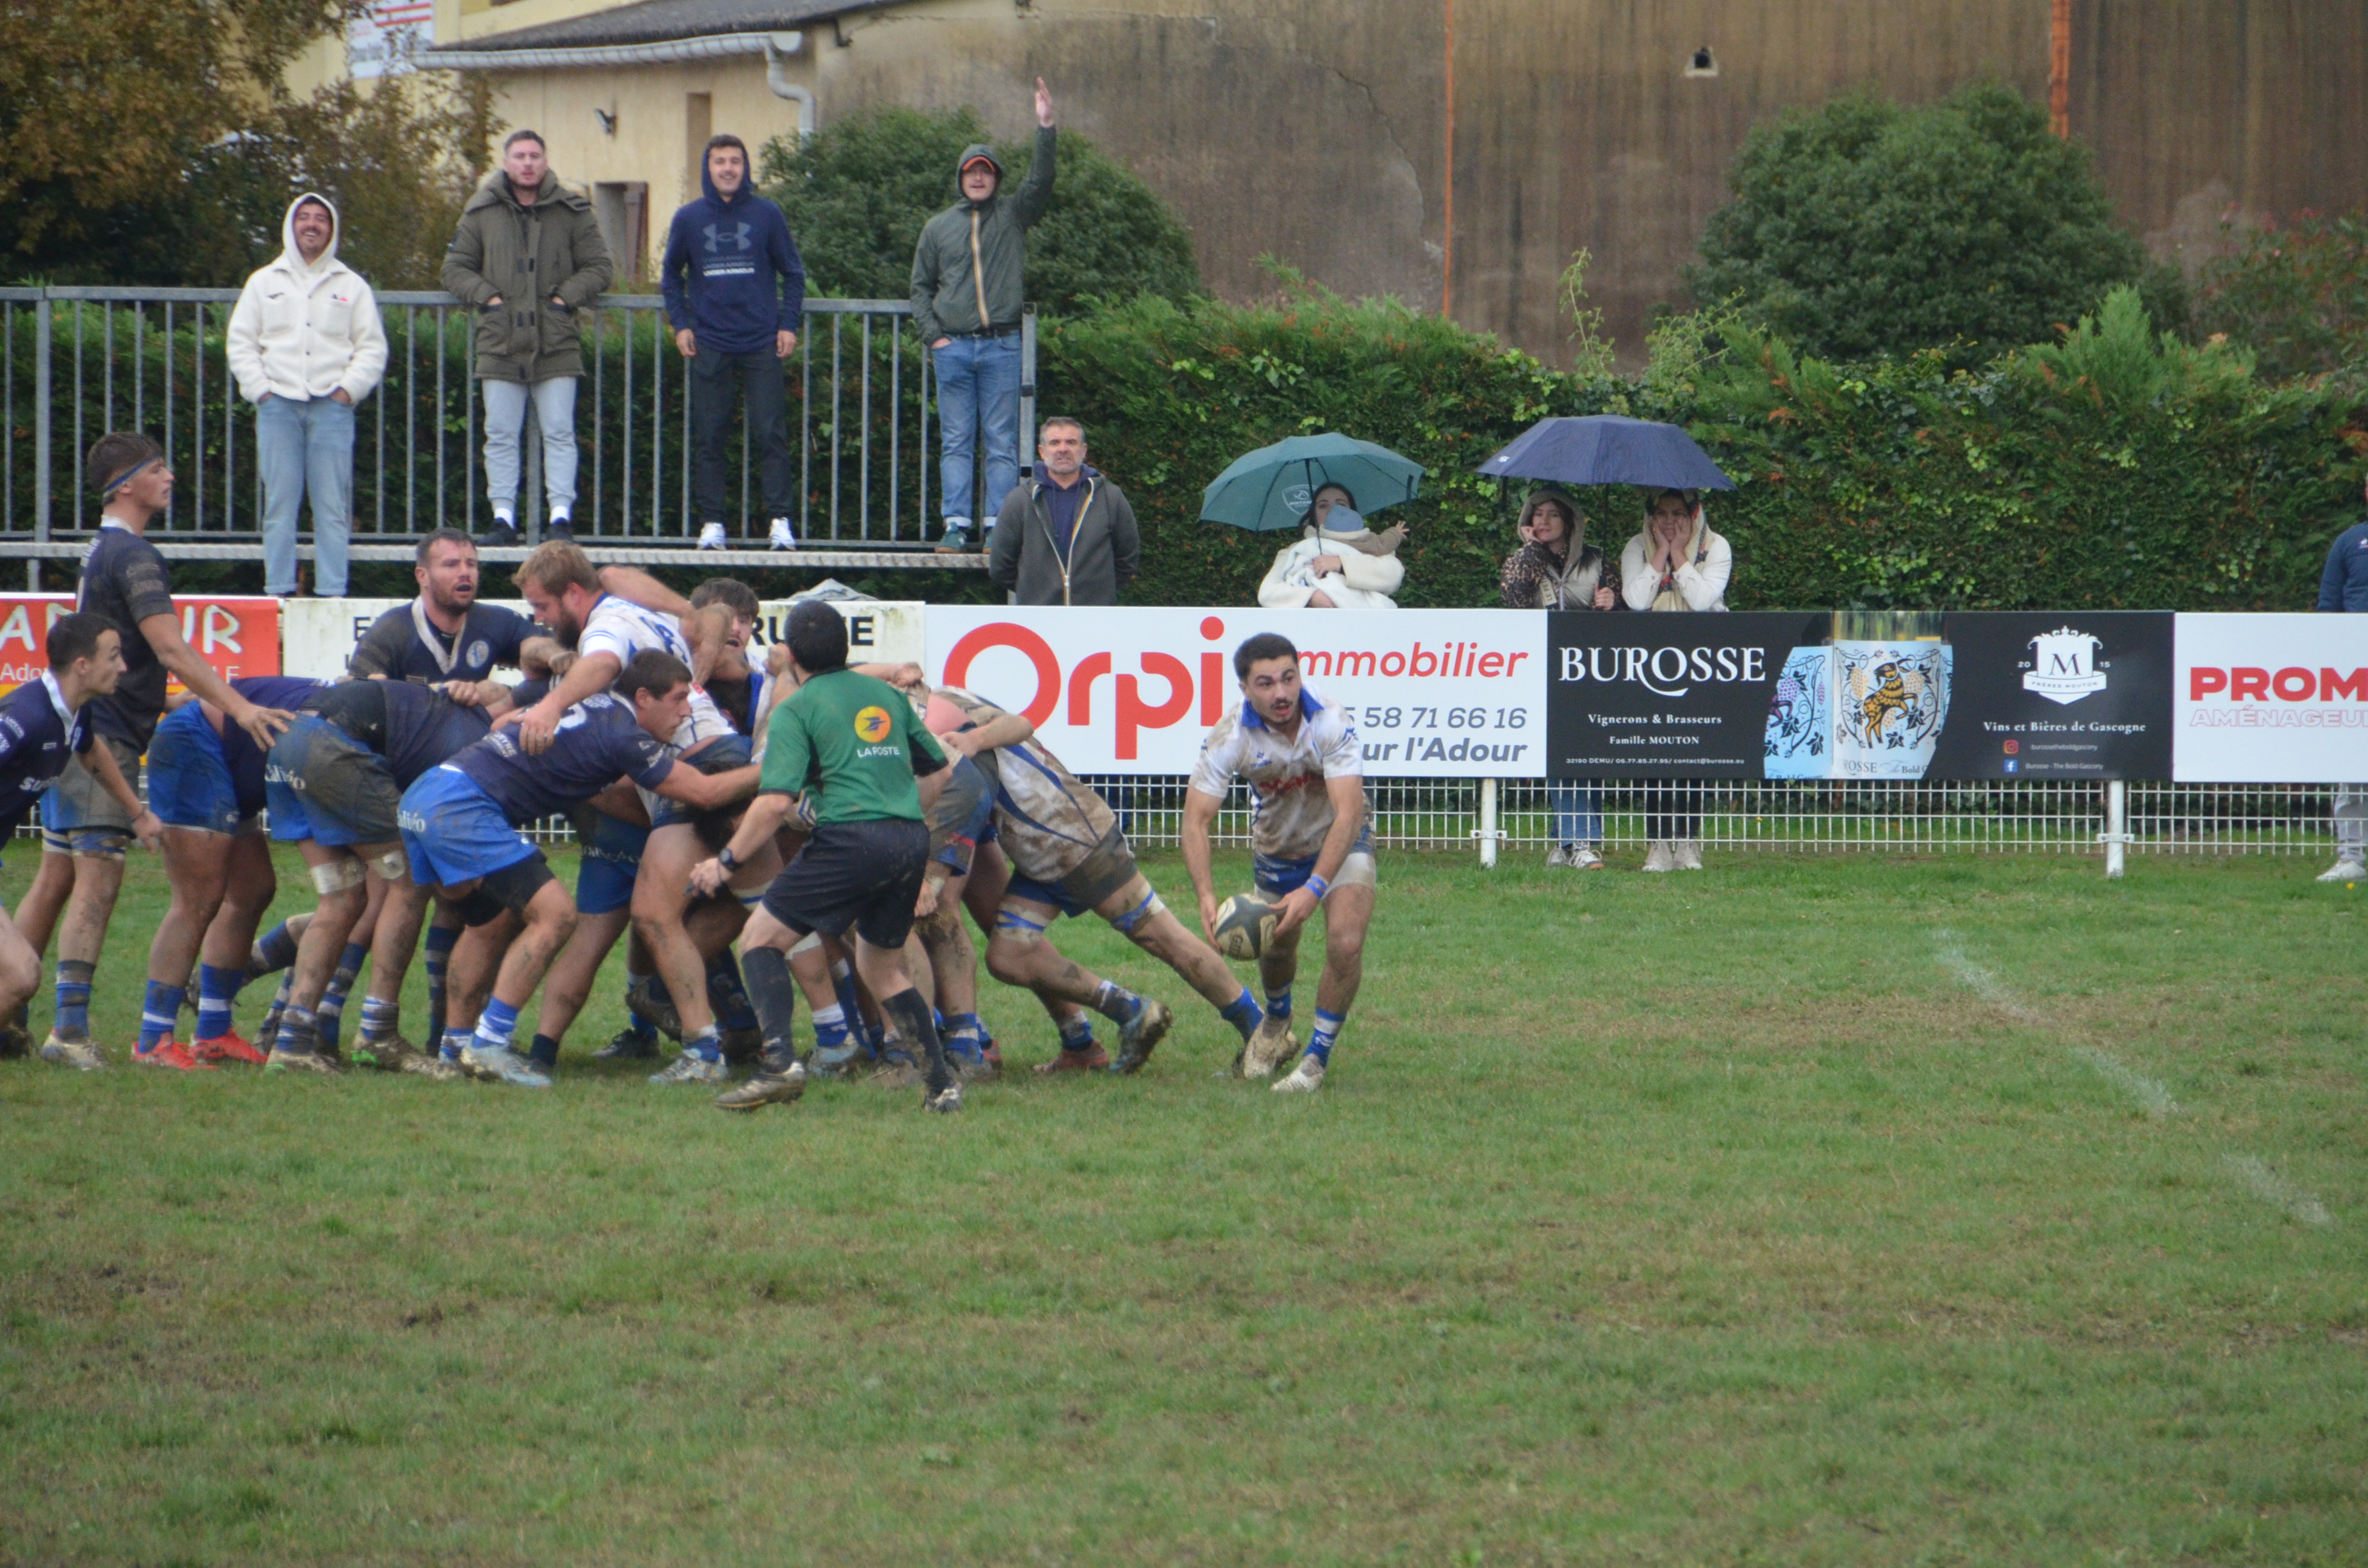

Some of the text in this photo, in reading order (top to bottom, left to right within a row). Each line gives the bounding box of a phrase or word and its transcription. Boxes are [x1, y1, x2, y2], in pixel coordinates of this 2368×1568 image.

[1297, 642, 1529, 677] mmobilier
[1559, 647, 1766, 697] BUROSSE
[942, 622, 1224, 760] Orpi
[2190, 667, 2368, 701] PROM
[1363, 707, 1402, 728] 58
[1411, 708, 1438, 728] 71
[1447, 707, 1486, 729] 66
[1493, 708, 1528, 729] 16
[1588, 714, 1723, 726] Vignerons & Brasseurs
[1983, 721, 2146, 735] Vins et Bières de Gascogne
[1362, 737, 1528, 762] ur l'Adour
[1609, 736, 1700, 744] Famille MOUTON
[857, 747, 900, 758] LA POSTE
